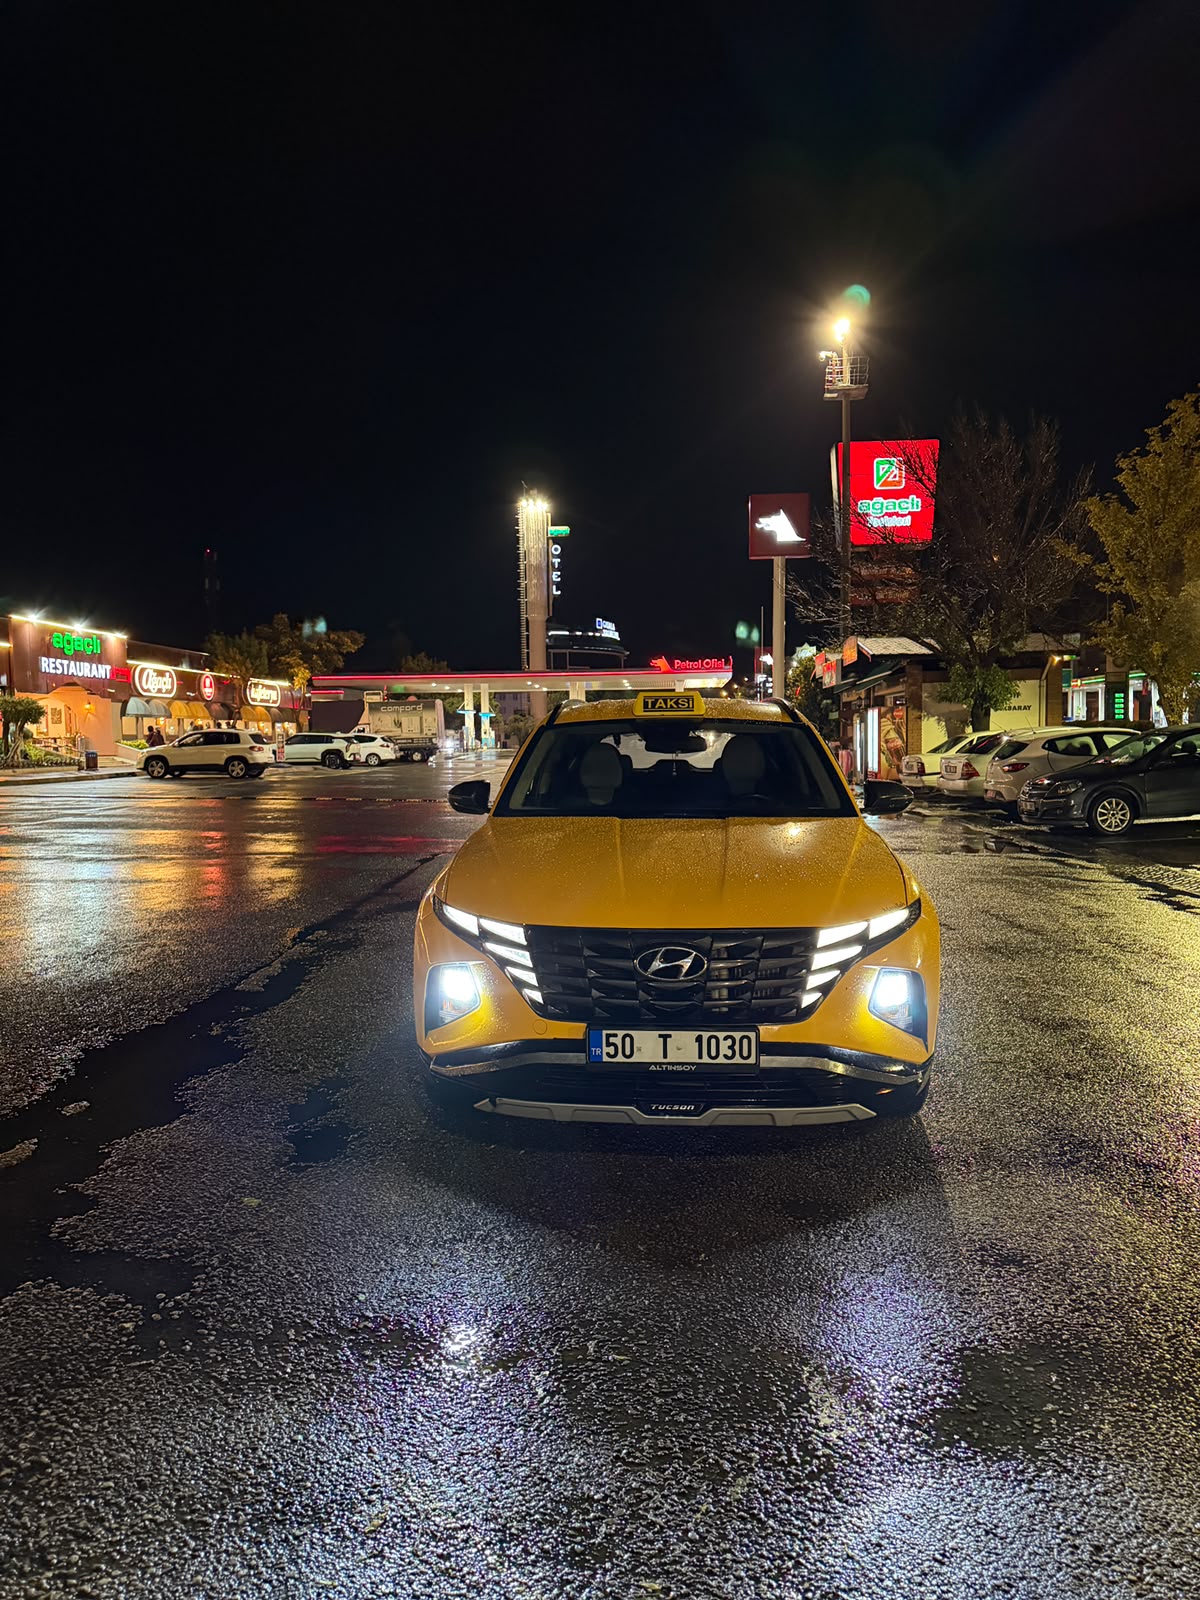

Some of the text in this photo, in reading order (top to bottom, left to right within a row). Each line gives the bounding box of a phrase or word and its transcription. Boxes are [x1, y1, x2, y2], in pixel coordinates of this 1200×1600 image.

[858, 494, 922, 517] ağaçlı
[551, 544, 562, 595] OTEL
[52, 632, 101, 656] ağaçlı
[40, 656, 112, 680] RESTAURANT
[674, 658, 726, 670] Petrol Ofisi
[380, 702, 423, 713] comford
[591, 1033, 753, 1061] TR 50 T 1030
